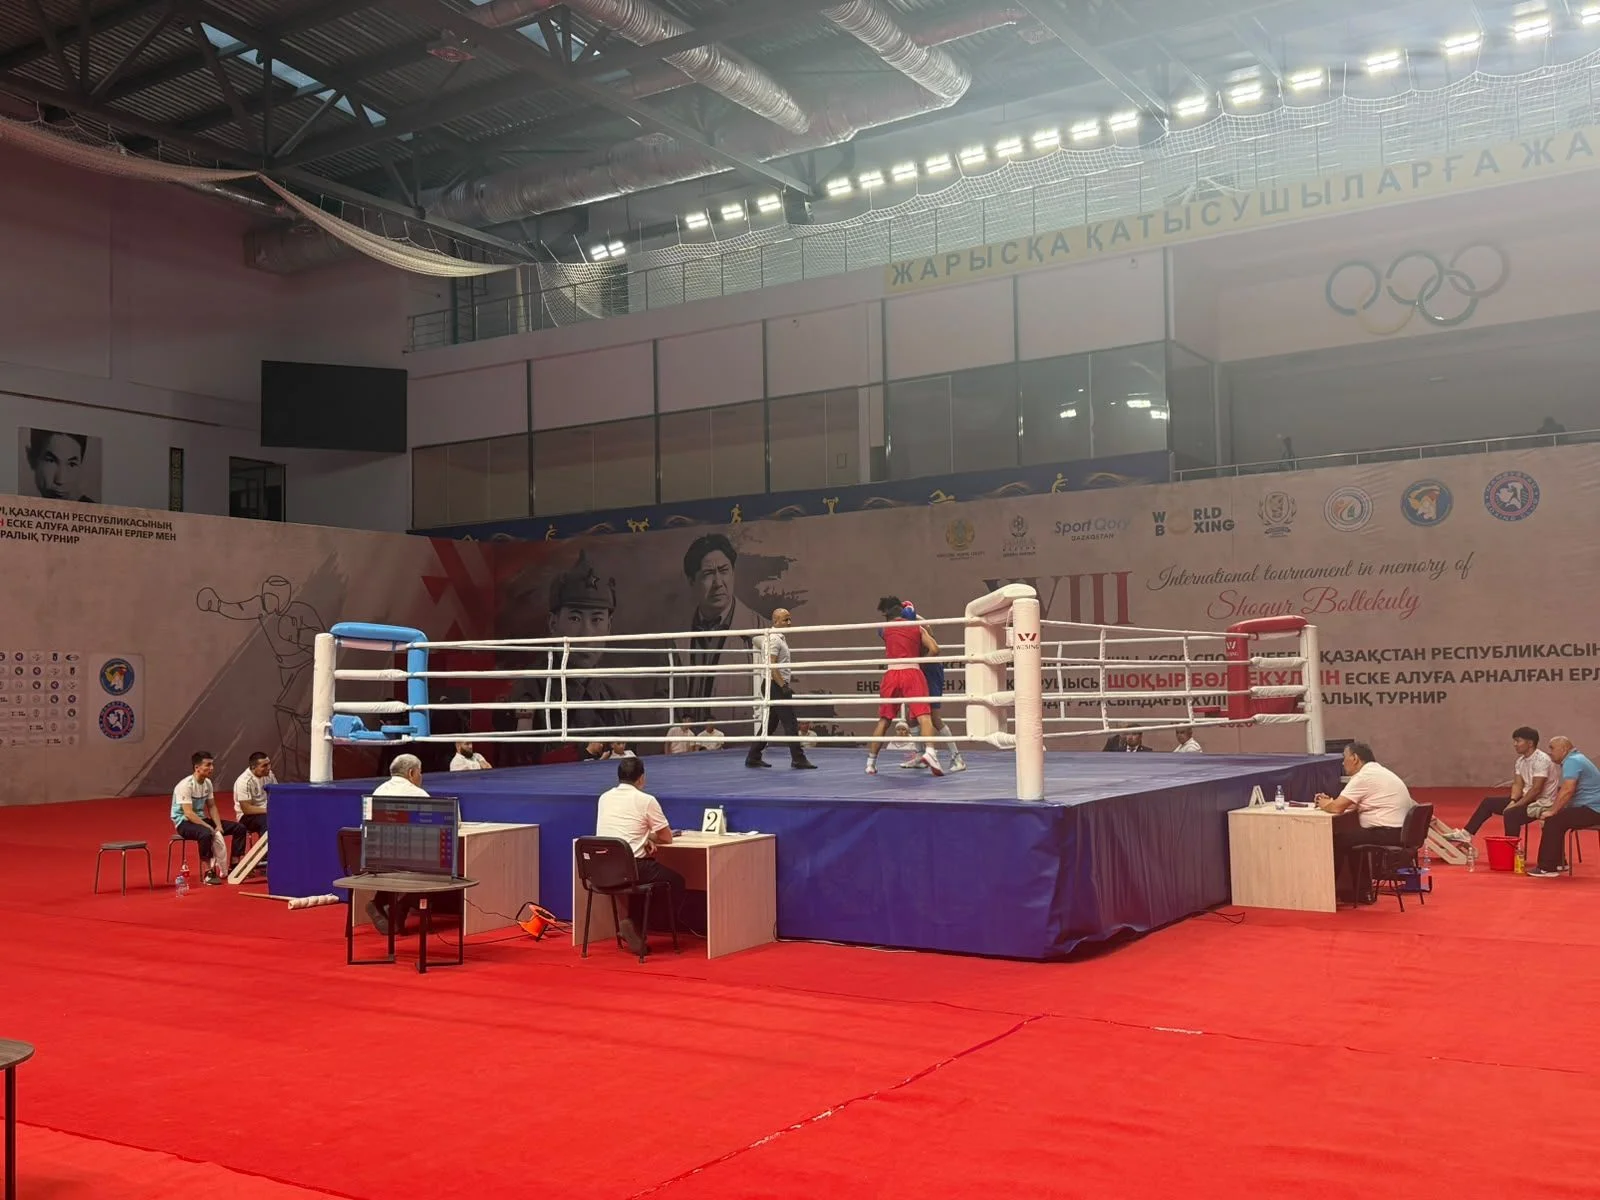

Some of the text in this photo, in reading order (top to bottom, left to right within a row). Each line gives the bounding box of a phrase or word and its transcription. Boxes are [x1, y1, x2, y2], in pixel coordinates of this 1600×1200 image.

[892, 231, 1070, 286] ЖАРЫСҚА
[1086, 149, 1501, 251] ҚАТЫСУШЫЛАРҒА
[6, 518, 33, 529] ЕСКЕ
[36, 521, 69, 532] АЛУҒА
[71, 524, 122, 537] АРНАЛҒАН
[124, 529, 153, 540] ЕРЛЕР
[155, 532, 176, 541] МЕН
[9, 506, 70, 520] ҚАЗАҚСТАН
[72, 513, 172, 531] РЕСПУБЛИКАСЫНЫҢ
[1055, 519, 1091, 536] Sport
[41, 533, 80, 544] ТУРНИР
[1146, 551, 1475, 591] International tournament in memory of
[1320, 648, 1426, 665] ҚАЗАҚСТАН
[1431, 643, 1600, 660] РЕСПУБЛИКАСЫН
[1107, 671, 1187, 691] ШОҚЫР
[1345, 672, 1390, 685] ЕСКЕ
[1395, 671, 1456, 685] АЛУҒА
[1460, 668, 1563, 684] АРНАЛҒАН
[1376, 690, 1448, 704] ТУРНИР
[705, 811, 718, 832] 2
